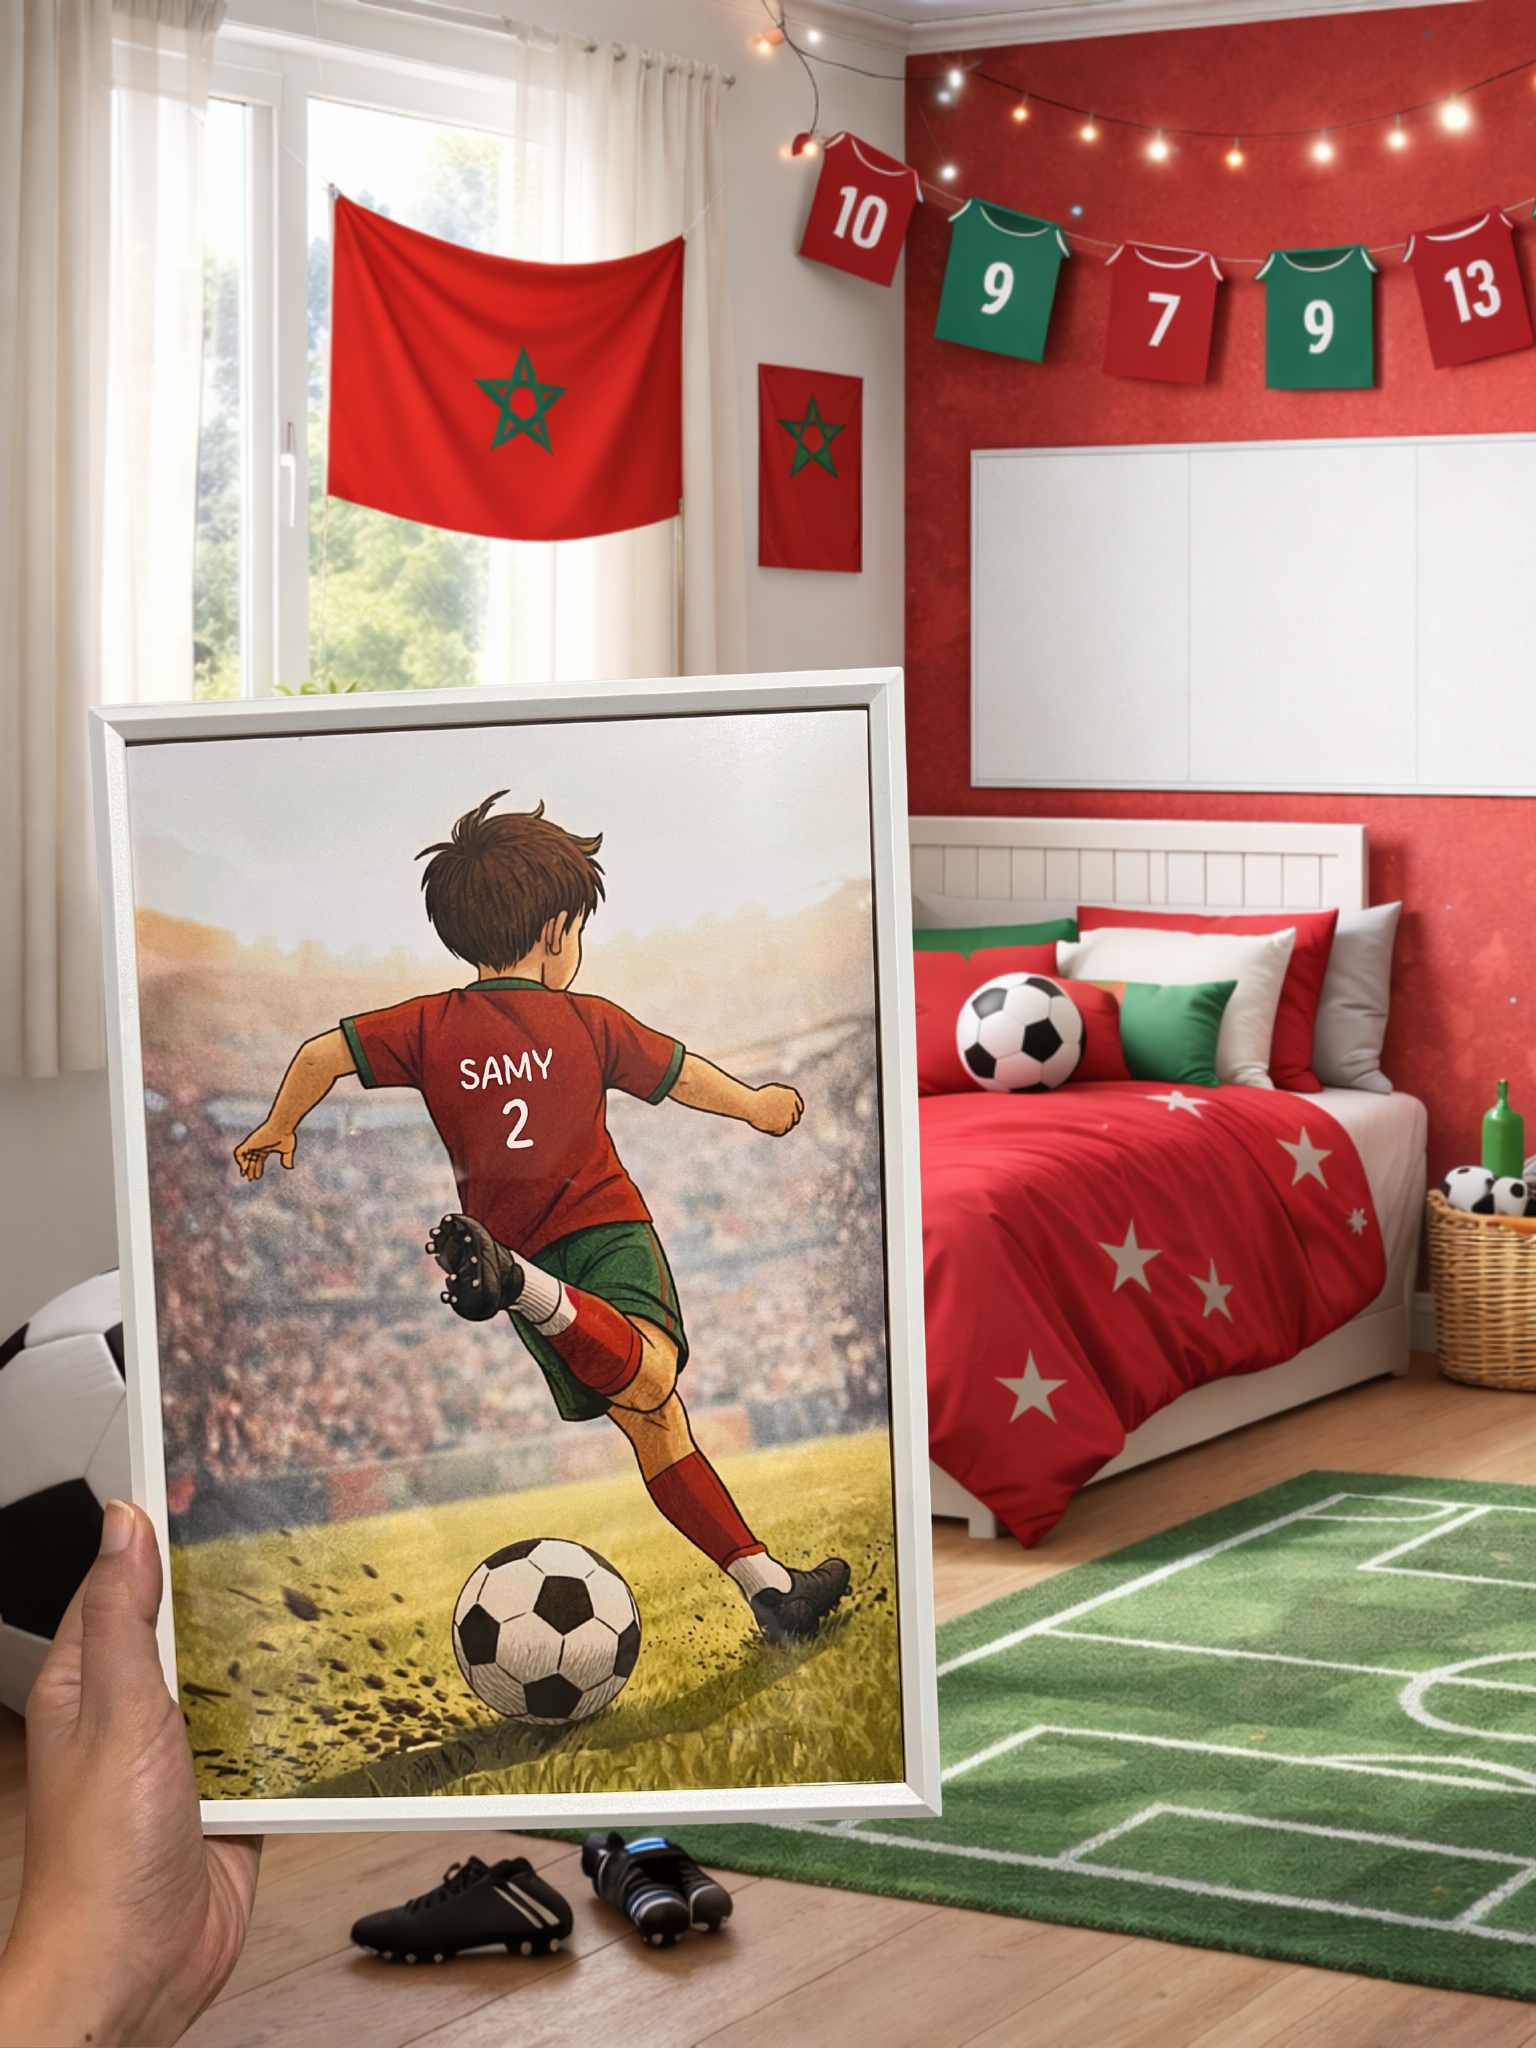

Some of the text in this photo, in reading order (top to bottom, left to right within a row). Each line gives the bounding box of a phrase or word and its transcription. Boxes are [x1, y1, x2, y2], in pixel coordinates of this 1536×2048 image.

[834, 186, 888, 249] 10
[981, 261, 1015, 315] 9
[1444, 259, 1502, 323] 13
[1148, 291, 1181, 347] 7
[1303, 299, 1335, 355] 9
[460, 1048, 553, 1090] SAMY
[502, 1098, 534, 1149] 2
